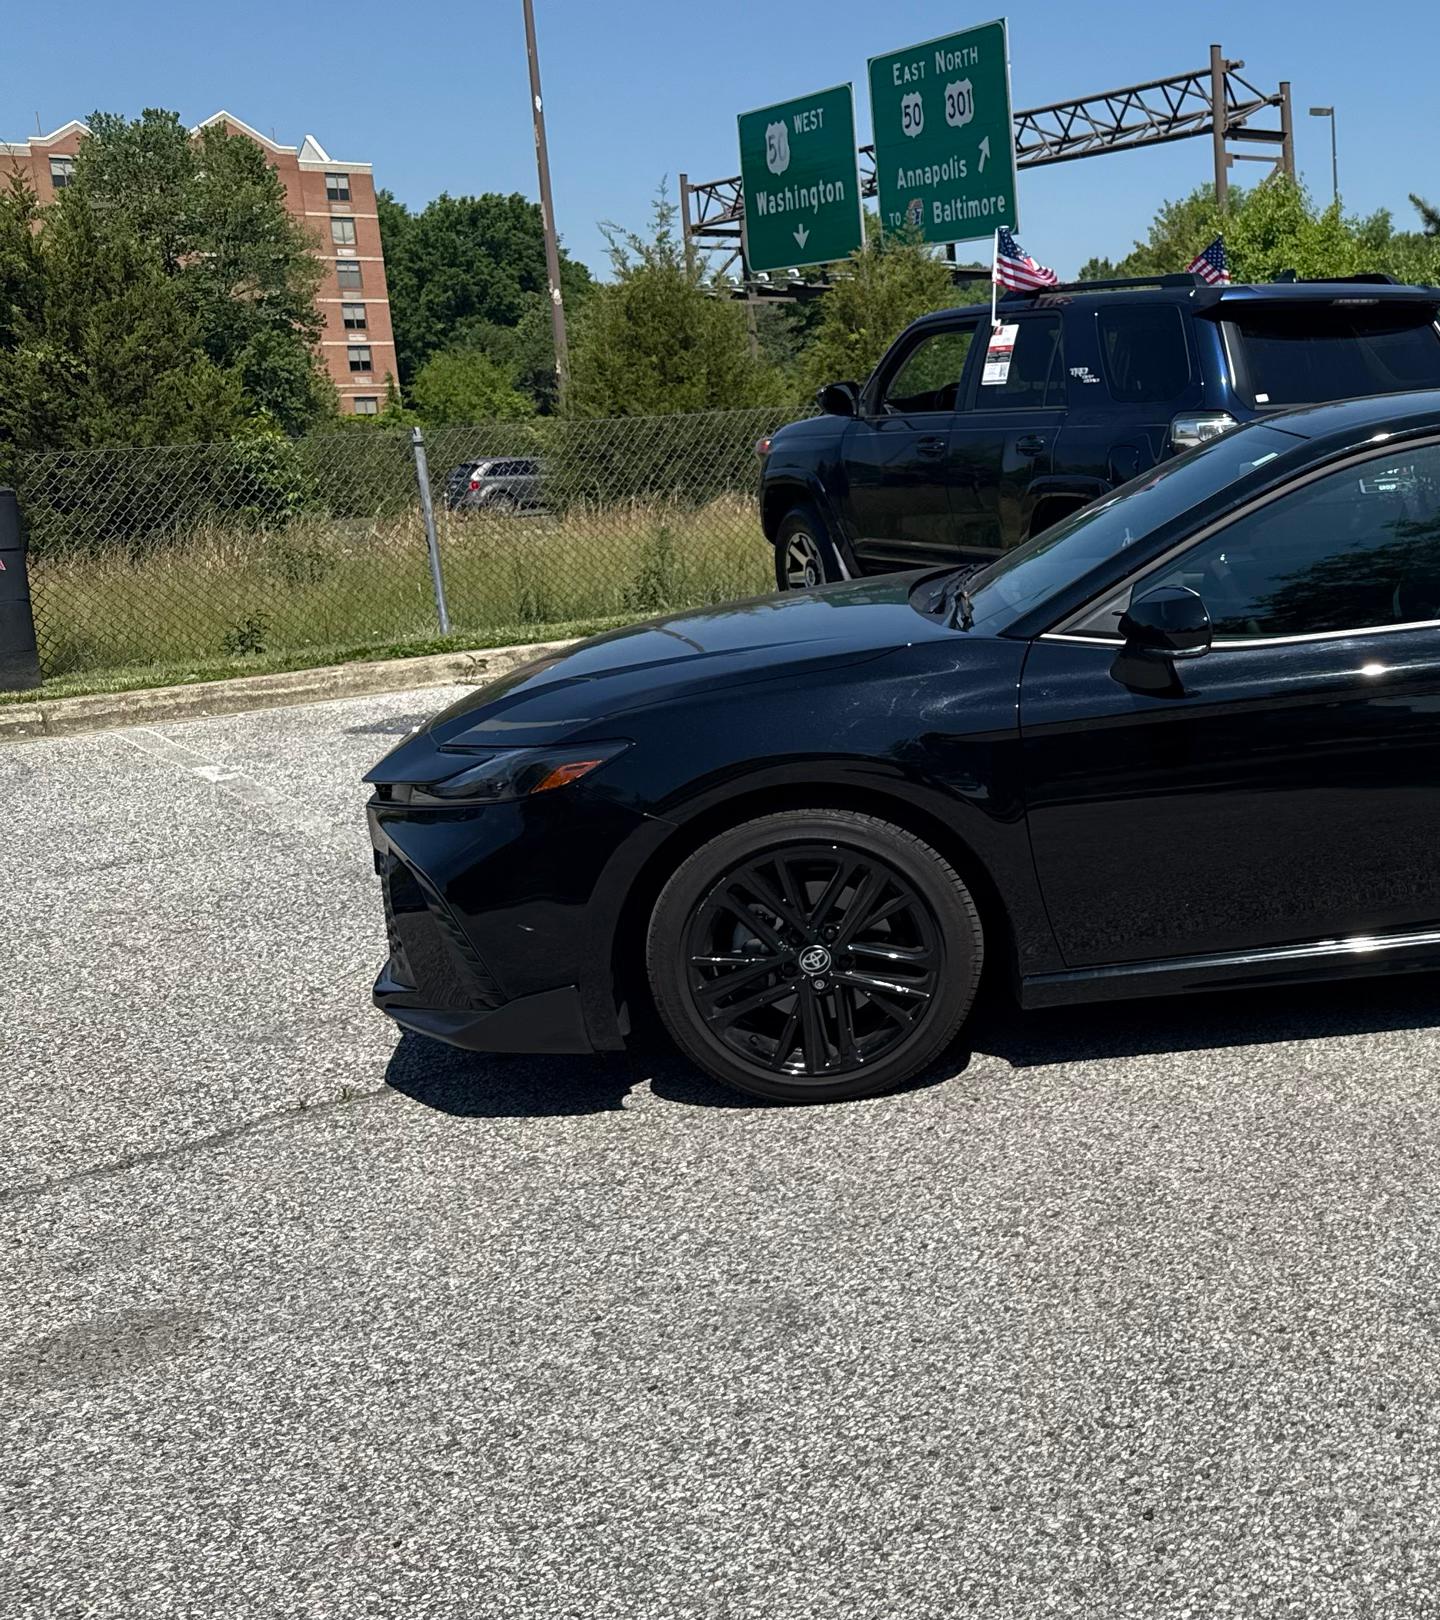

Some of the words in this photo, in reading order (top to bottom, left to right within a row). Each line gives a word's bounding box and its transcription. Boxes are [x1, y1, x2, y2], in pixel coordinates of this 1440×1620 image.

[892, 62, 925, 86] EAST
[935, 46, 978, 75] NORTH
[793, 108, 823, 134] WEST
[904, 103, 921, 129] 50
[947, 89, 972, 119] 301
[768, 134, 787, 164] 50
[897, 155, 967, 190] Annapolis
[756, 180, 844, 216] Washington
[932, 195, 1006, 224] Baltimore
